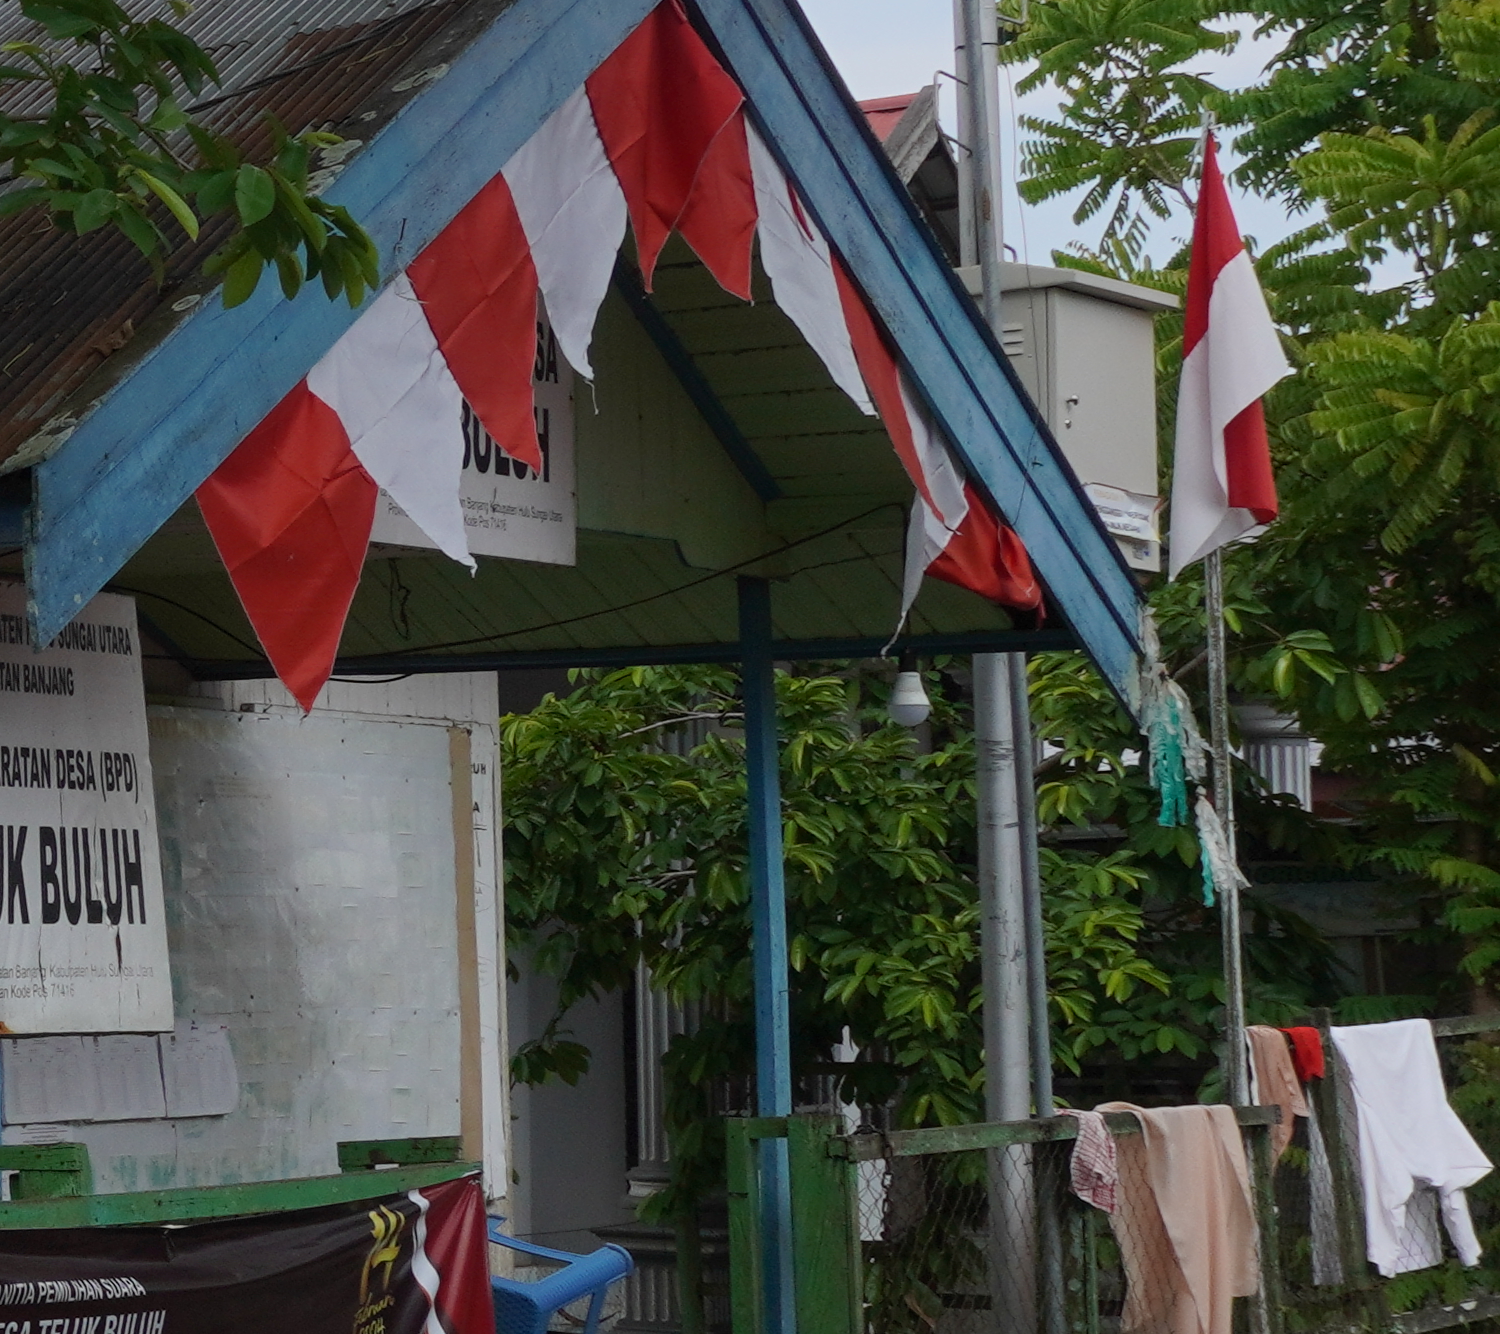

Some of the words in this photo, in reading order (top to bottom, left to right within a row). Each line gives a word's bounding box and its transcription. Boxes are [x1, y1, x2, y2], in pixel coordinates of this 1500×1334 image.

[99, 627, 132, 656] UTARA
[23, 664, 74, 696] BANJANG
[55, 749, 96, 790] DESA
[100, 752, 138, 803] (BPD)
[39, 826, 146, 924] BULUH
[38, 1279, 103, 1302] PEMILIHAN
[100, 1277, 146, 1298] SUARA
